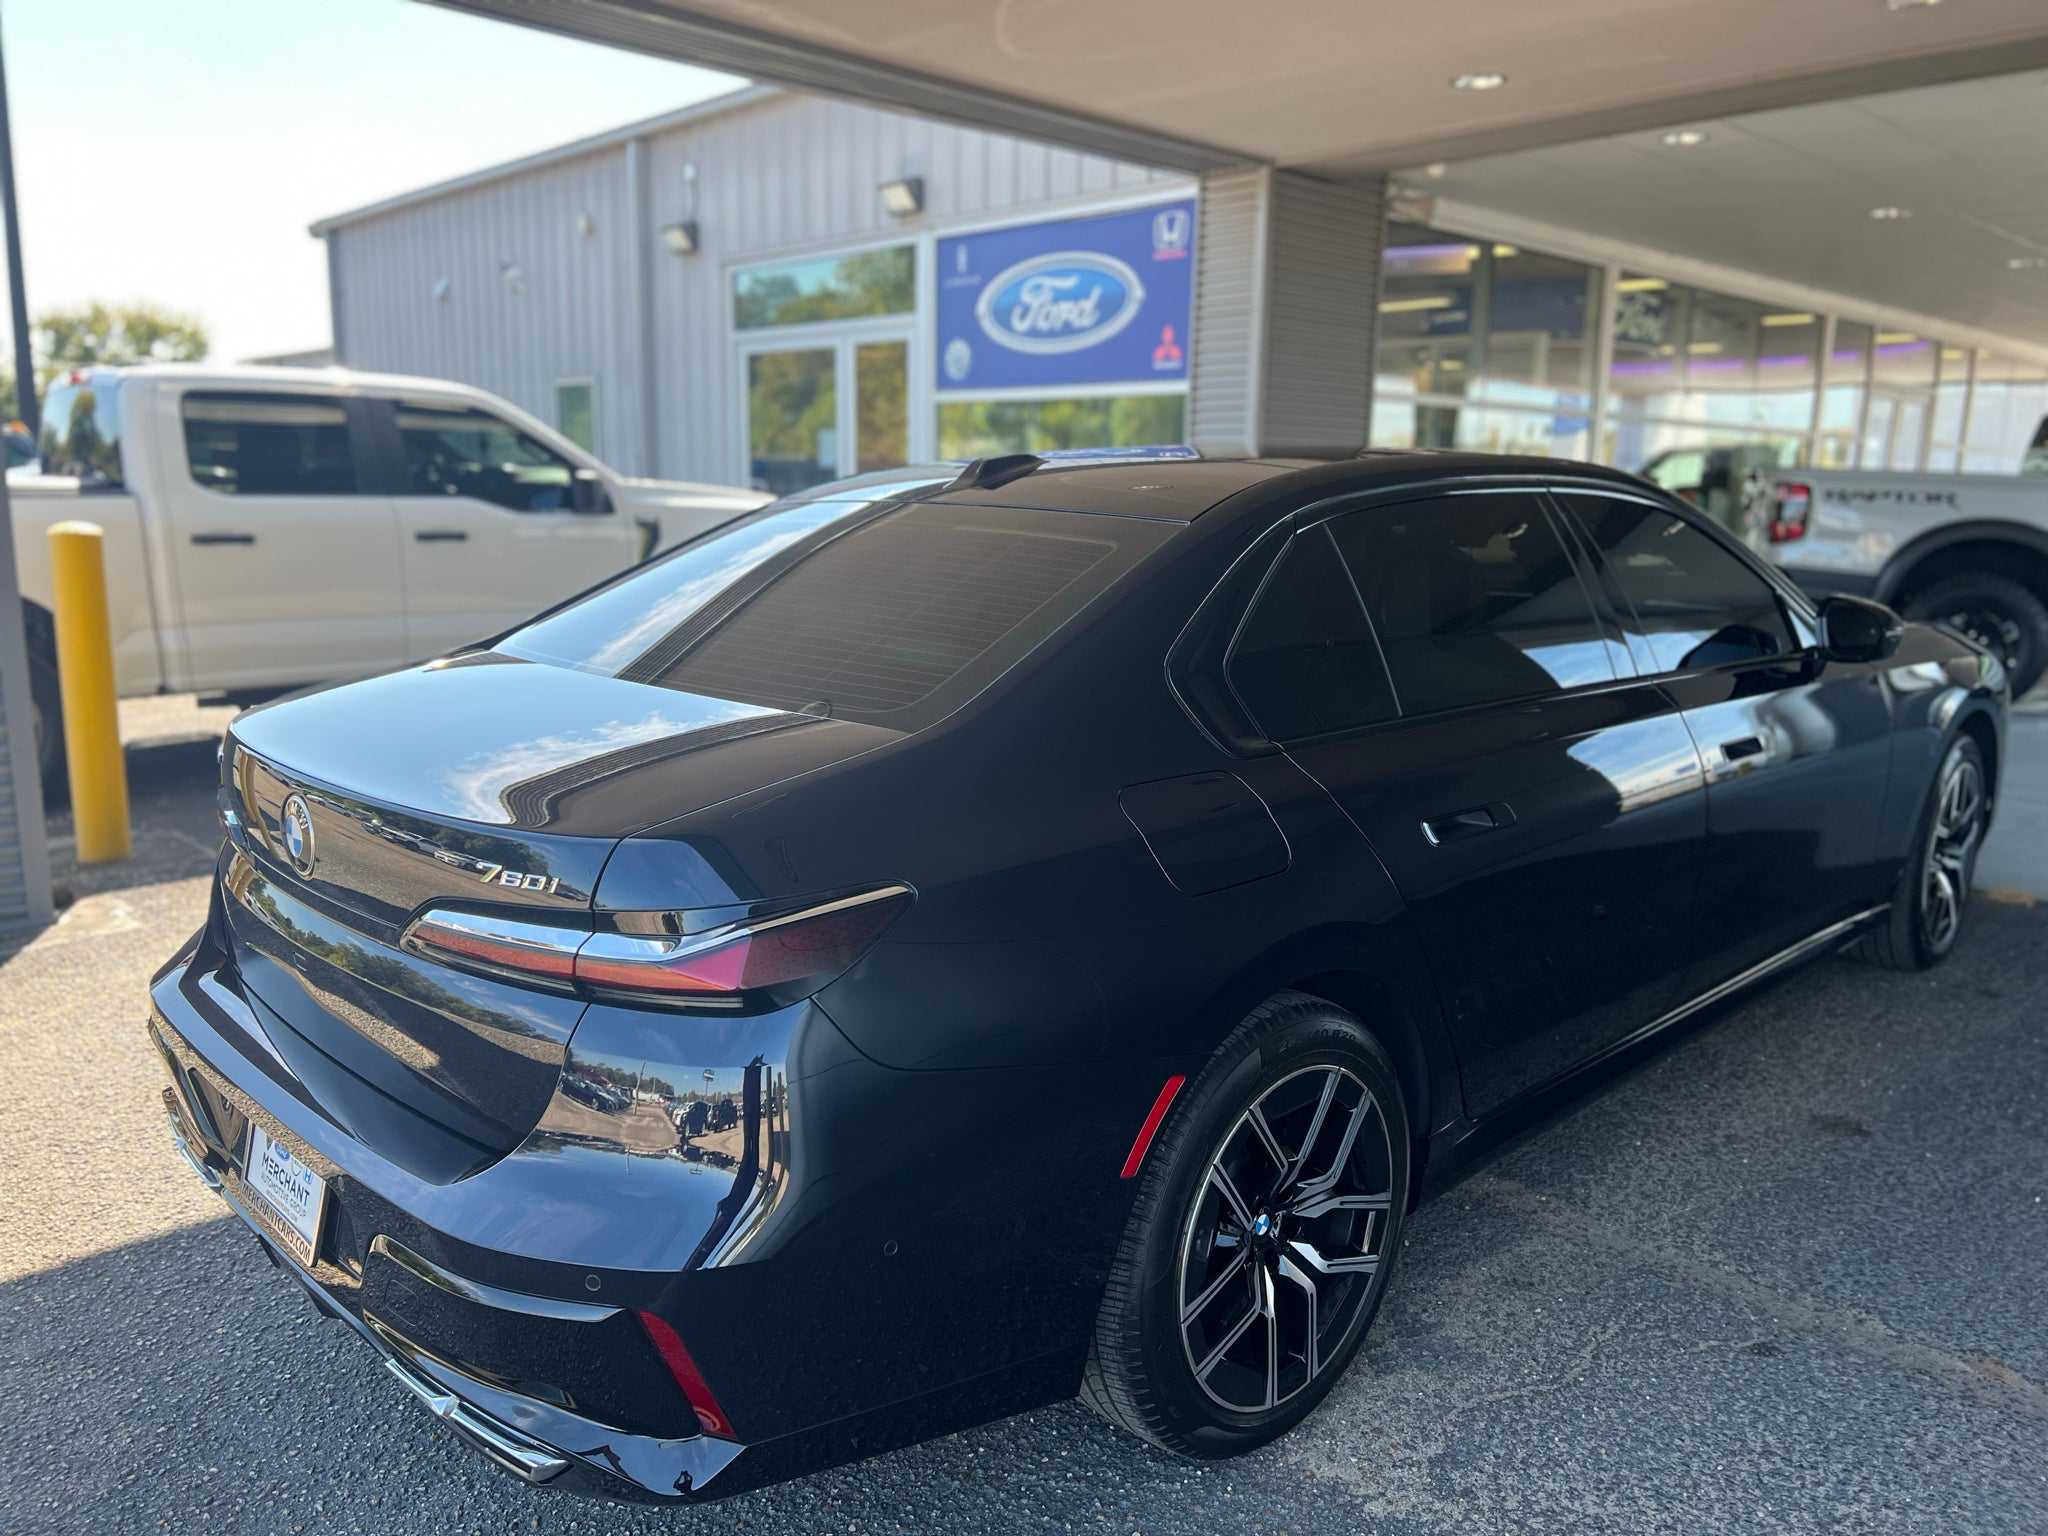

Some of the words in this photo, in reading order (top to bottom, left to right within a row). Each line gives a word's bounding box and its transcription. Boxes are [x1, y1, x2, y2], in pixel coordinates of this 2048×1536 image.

[1010, 274, 1103, 334] Ford
[475, 861, 561, 894] 760i
[261, 1152, 310, 1205] MERCHANT
